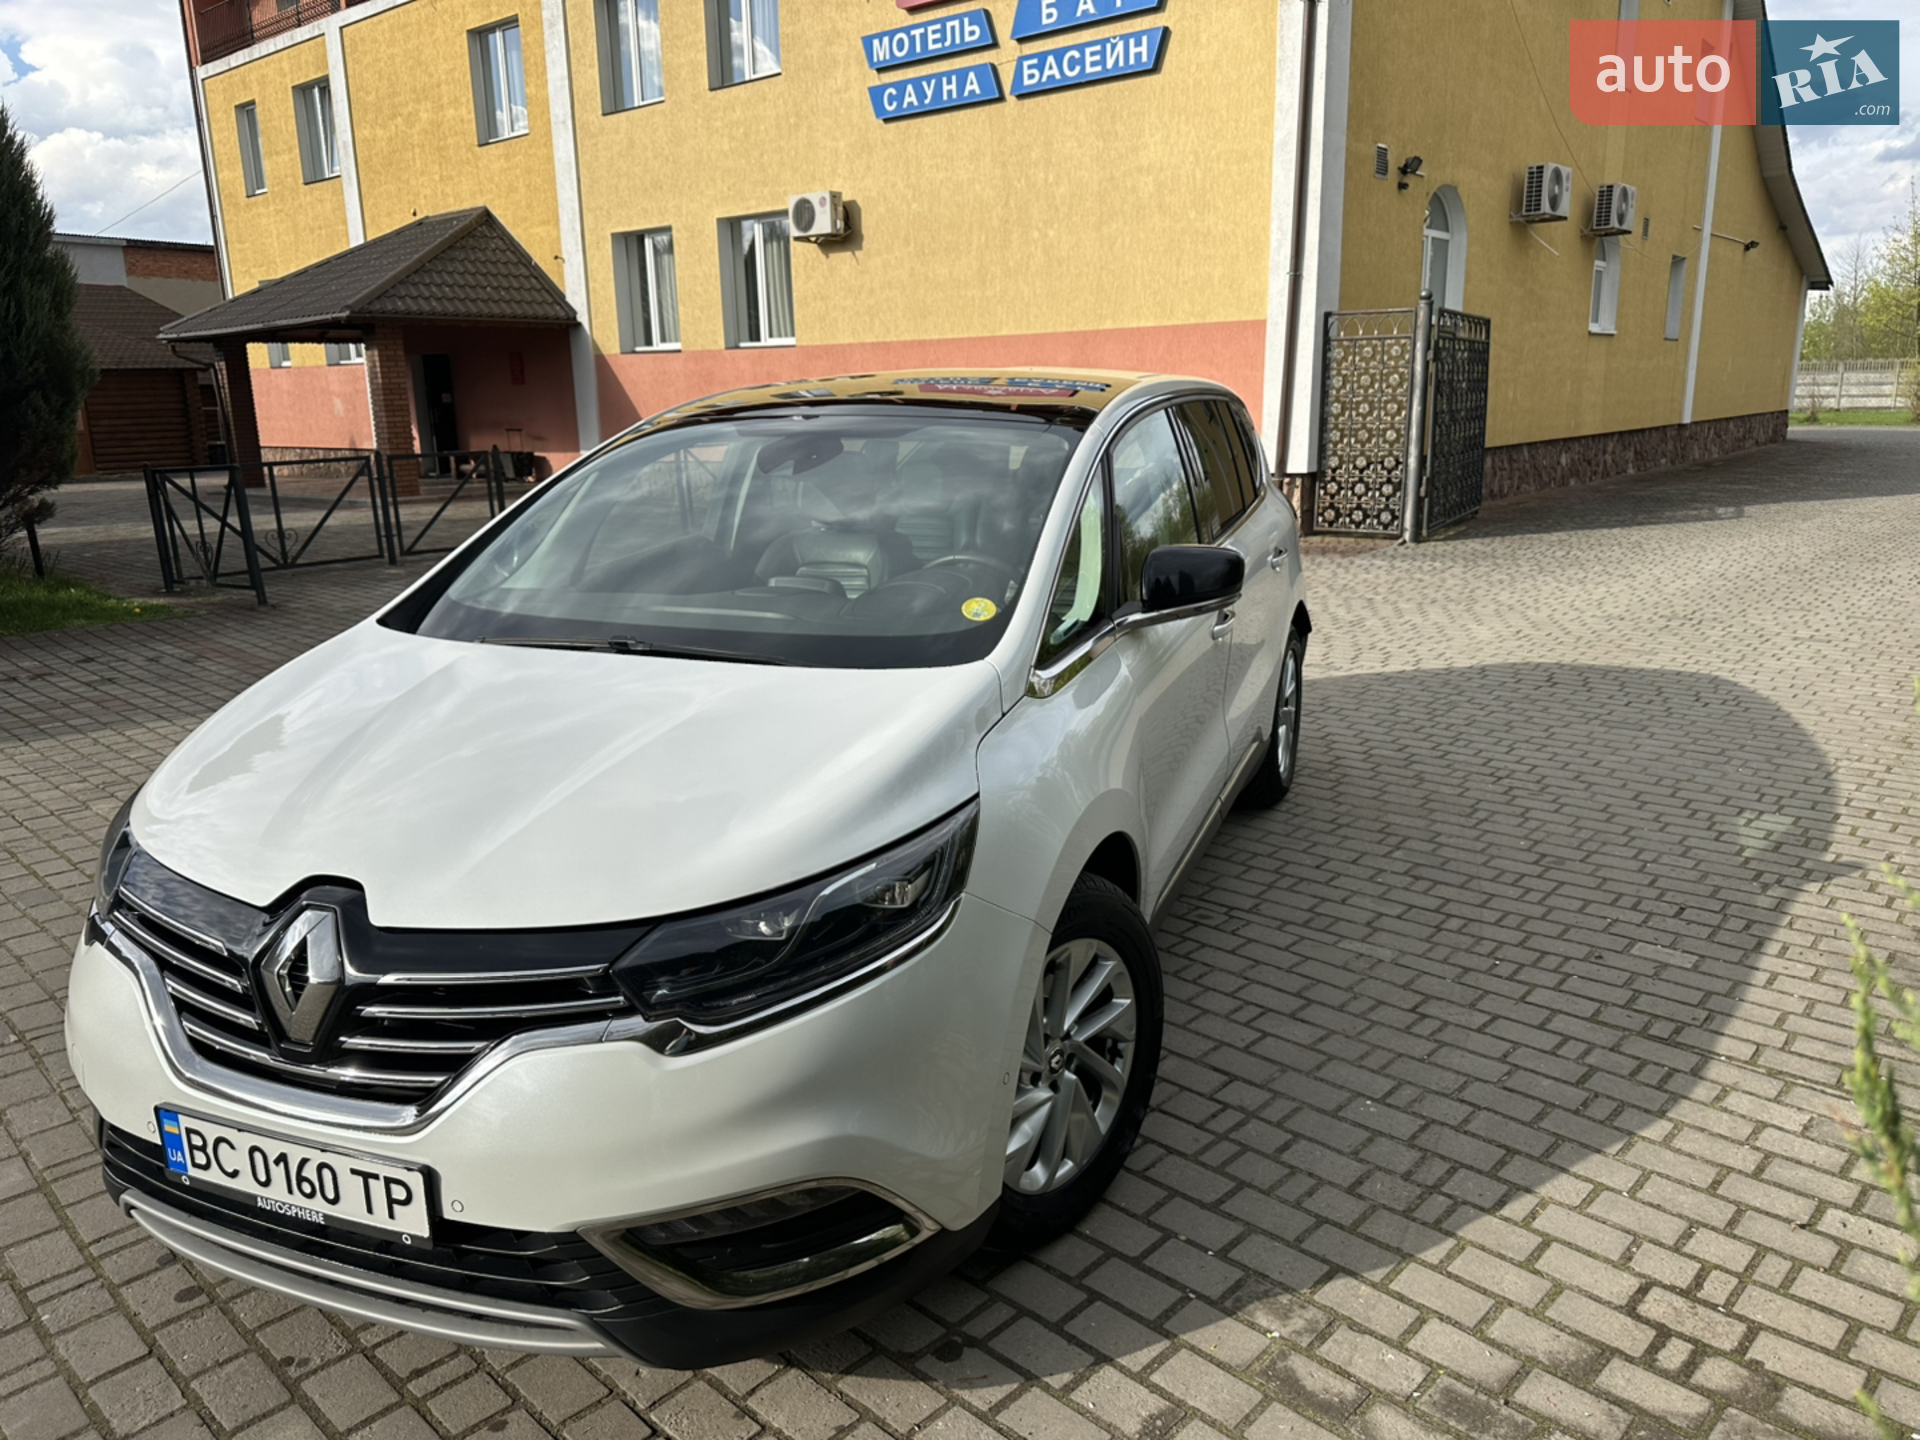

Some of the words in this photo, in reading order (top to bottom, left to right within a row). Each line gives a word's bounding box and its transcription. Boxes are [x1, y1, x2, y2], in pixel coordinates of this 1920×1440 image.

[1041, 0, 1122, 25] БА
[871, 17, 982, 63] МОТЕЛЬ
[1021, 34, 1149, 87] БАСЕЙН
[882, 70, 982, 113] САУНА
[168, 1147, 185, 1164] UA
[184, 1126, 240, 1180] BC
[248, 1144, 340, 1206] 0160
[349, 1167, 413, 1220] TP
[256, 1195, 326, 1226] AUTOSPHERE
